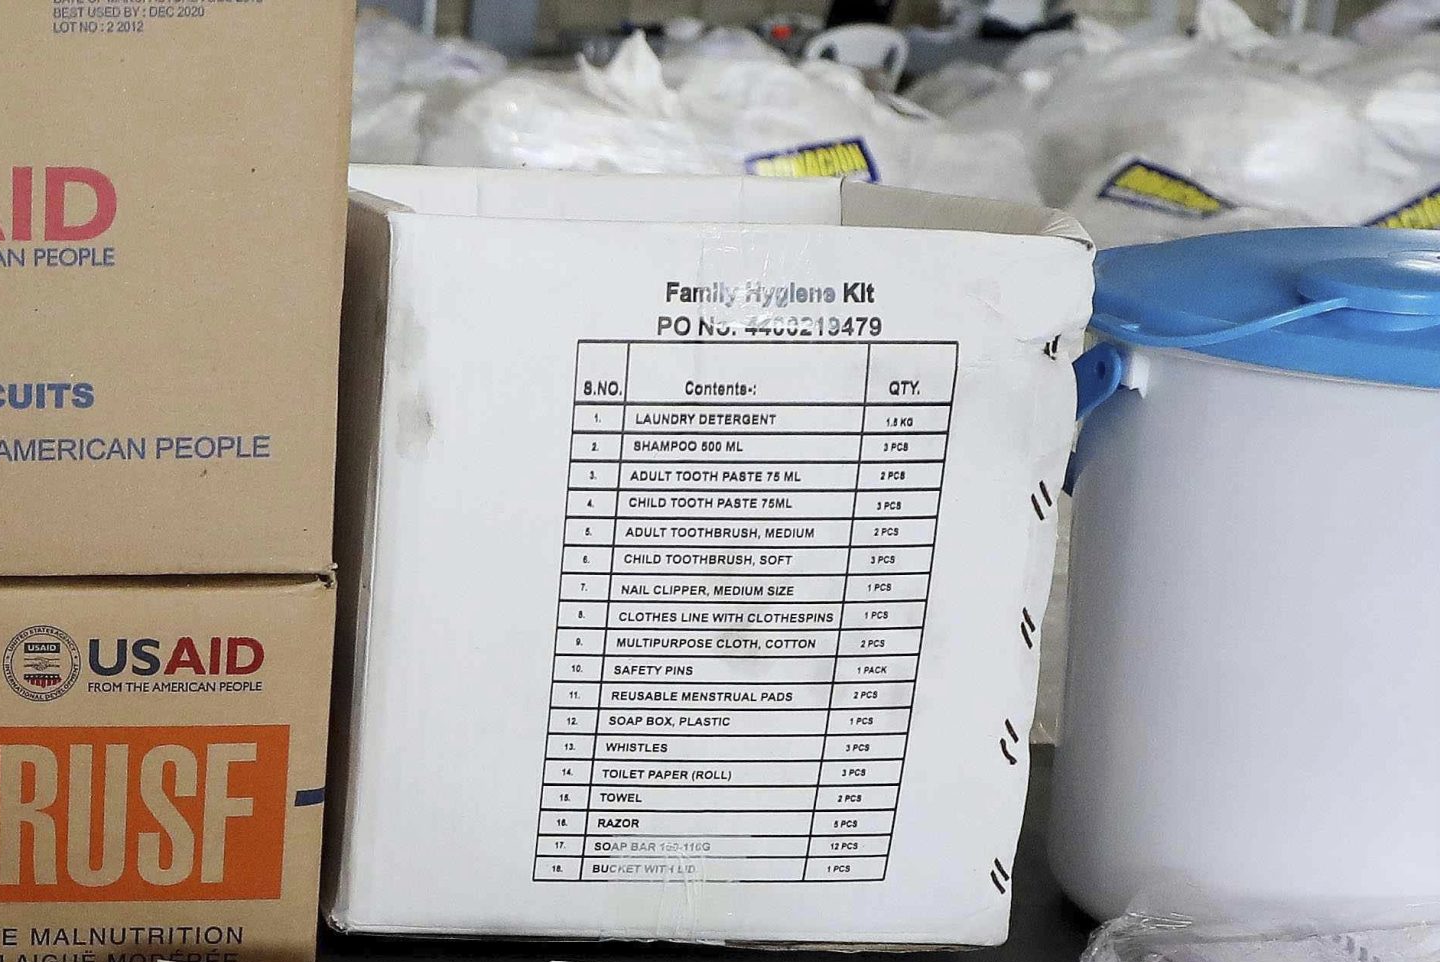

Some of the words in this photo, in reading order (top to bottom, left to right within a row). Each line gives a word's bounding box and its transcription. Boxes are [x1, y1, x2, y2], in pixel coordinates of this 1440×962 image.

[53, 7, 84, 19] BEST
[88, 7, 121, 18] USED
[149, 6, 174, 18] DEC
[177, 5, 205, 17] 2020
[53, 21, 77, 33] LOT
[34, 247, 115, 267] PEOPLE
[665, 281, 737, 306] Family
[745, 282, 836, 307] Hygiene
[843, 282, 875, 303] Kit
[657, 316, 691, 337] PO
[889, 381, 919, 395] QTY.
[636, 414, 695, 424] LAUNDRY
[699, 414, 776, 425] DETERGENT
[156, 436, 270, 459] PEOPLE
[634, 441, 697, 451] SHAMPOO
[702, 441, 721, 451] 500
[726, 441, 743, 451] ML
[625, 527, 667, 537] ADULT
[671, 528, 760, 539] TOOTHBRUSH,
[765, 528, 814, 538] MEDIUM
[622, 585, 649, 594] NAIL
[654, 585, 709, 596] CLIPPER,
[714, 586, 763, 596] MEDIUM
[768, 586, 794, 596] SIZE
[619, 612, 677, 622] CLOTHES
[681, 613, 708, 622] LINE
[713, 613, 743, 622] WITH
[748, 613, 833, 623] CLOTHESPINS
[27, 644, 57, 652] USAID
[89, 637, 264, 676] USAID
[614, 666, 662, 675] SAFETY
[665, 666, 693, 675] PINS
[88, 682, 122, 692] FROM
[125, 682, 149, 692] THE
[152, 682, 216, 692] AMERICAN
[220, 682, 262, 692] PEOPLE
[612, 692, 677, 701] REUSABLE
[682, 692, 757, 701] MENSTRUAL
[761, 692, 792, 701] PADS
[606, 743, 667, 752] WHISTLES
[602, 770, 644, 779] TOILET
[648, 770, 688, 779] PAPER
[692, 771, 731, 781] (ROLL)
[600, 793, 642, 802] TOWEL
[598, 819, 639, 828] RAZOR
[31, 926, 244, 946] MALNUTRITION
